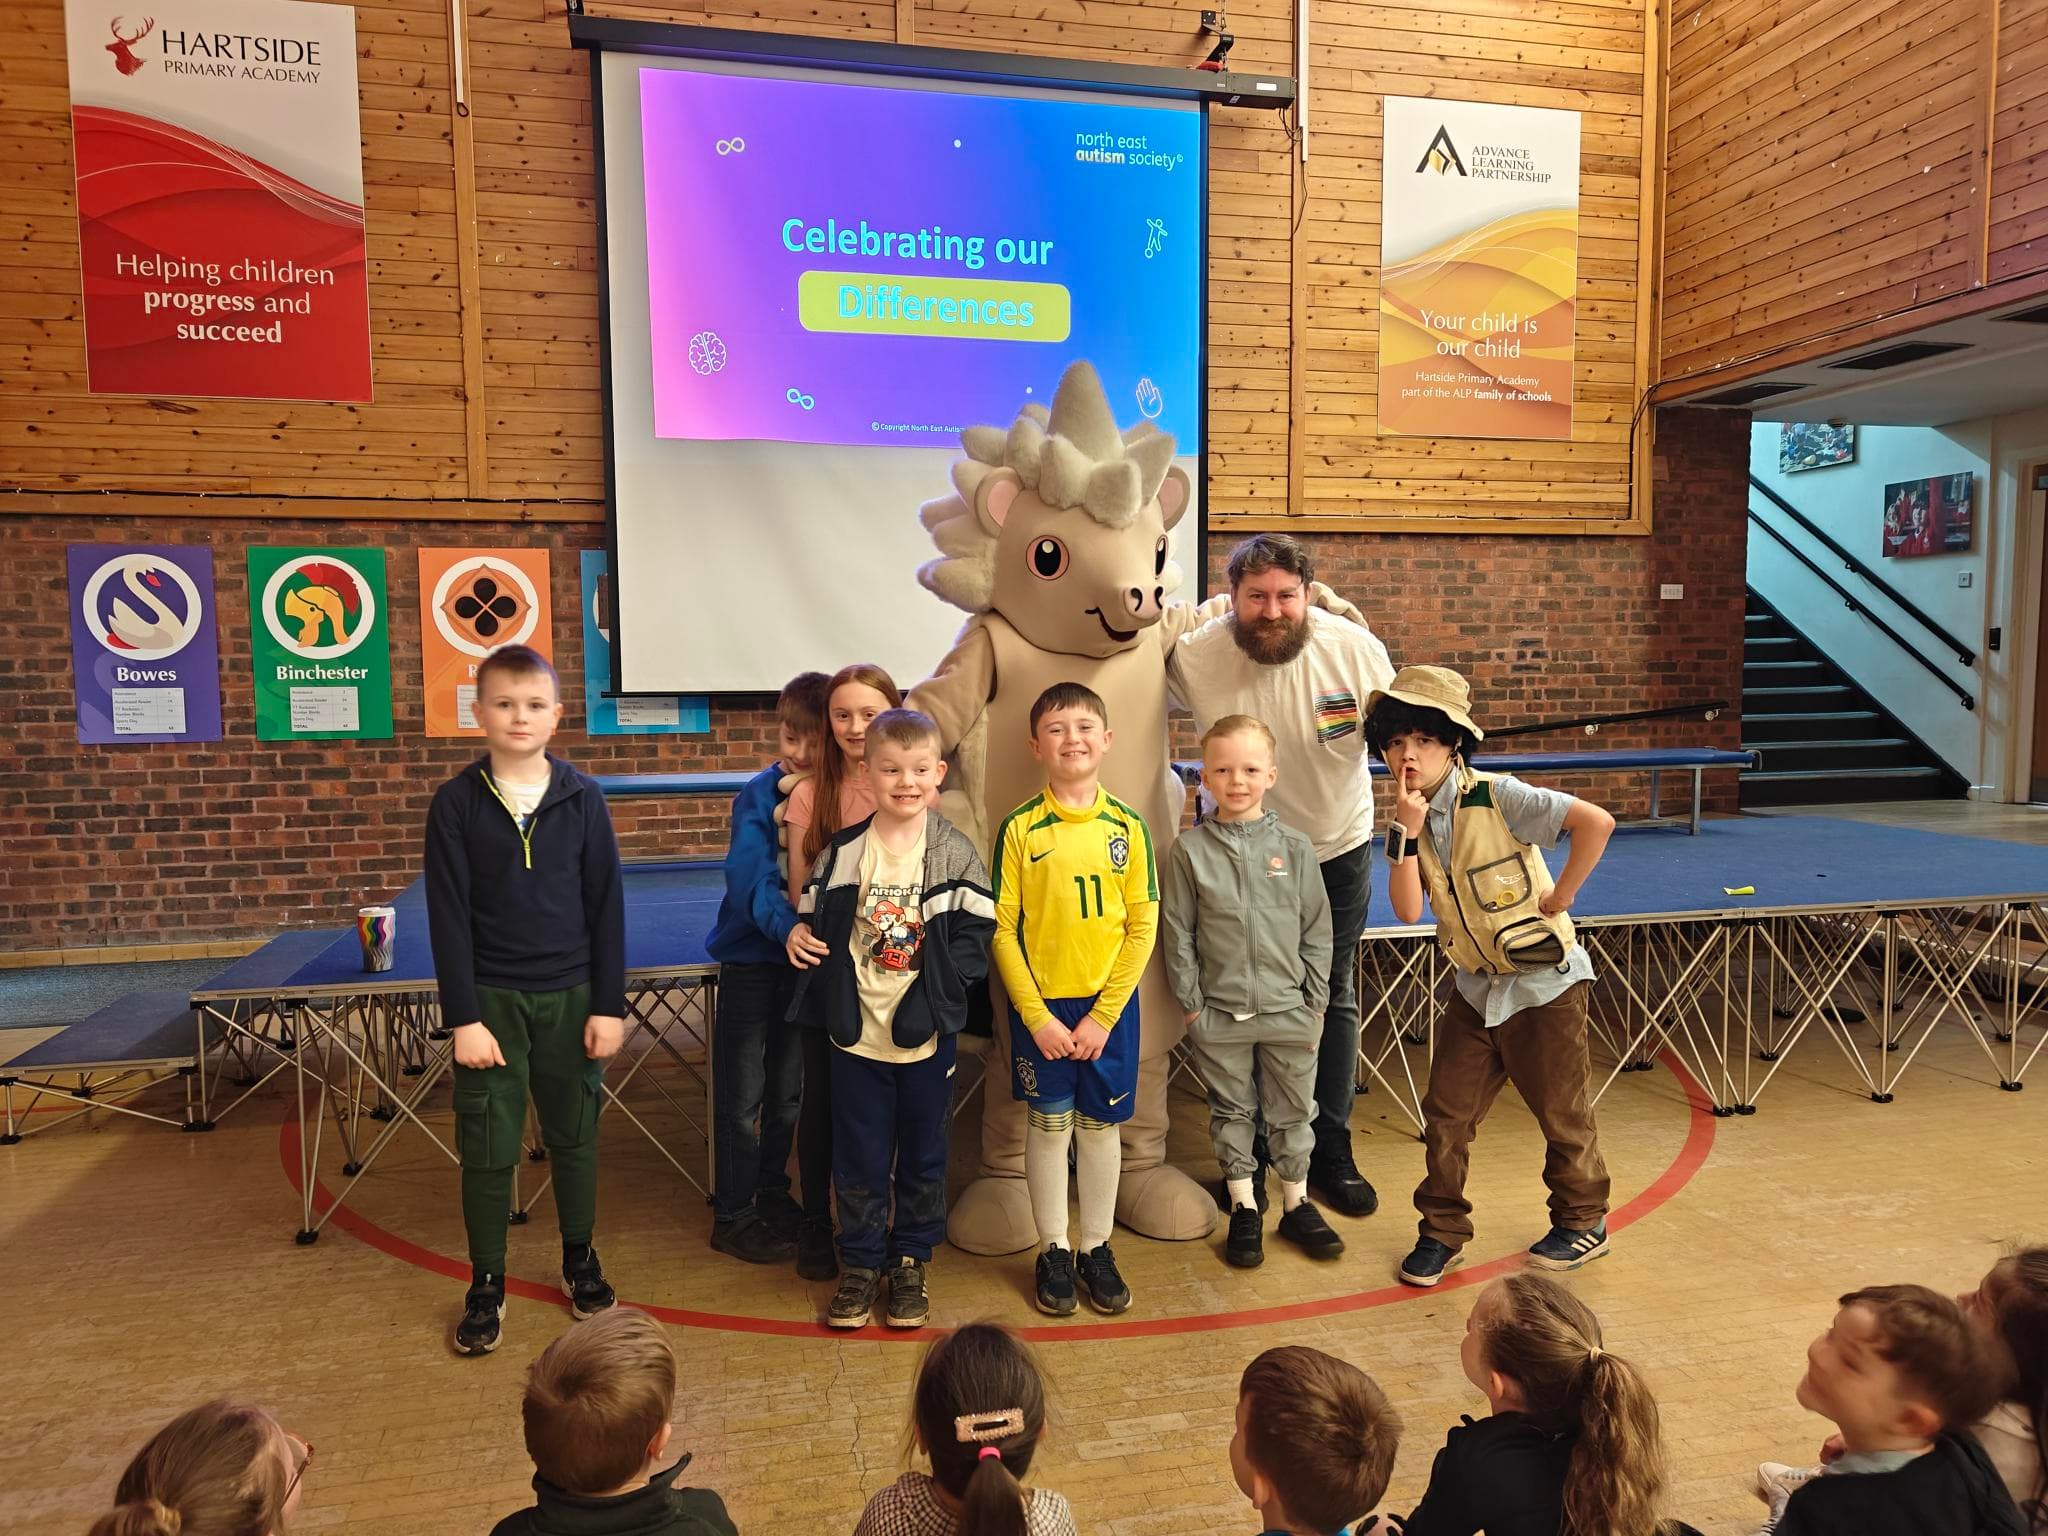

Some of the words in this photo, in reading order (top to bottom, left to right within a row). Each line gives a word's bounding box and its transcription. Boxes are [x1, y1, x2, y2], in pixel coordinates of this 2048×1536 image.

[162, 30, 321, 66] HARTSIDE
[164, 60, 236, 79] PRIMARY
[241, 67, 321, 84] ACADEMY
[1076, 131, 1114, 148] north
[1117, 136, 1147, 150] east
[1075, 148, 1125, 164] autism
[1472, 146, 1530, 160] ADVANCE
[1472, 157, 1534, 171] LEARNING
[1472, 168, 1552, 184] PARTNERSHIP
[781, 218, 985, 269] Celebrating
[995, 237, 1054, 265] our
[116, 253, 221, 286] Helping
[229, 258, 334, 285] children
[144, 290, 255, 316] progress
[264, 292, 310, 314] and
[838, 284, 1035, 328] Differences
[177, 321, 282, 343] succeed
[1421, 310, 1466, 330] Your
[1471, 312, 1517, 333] child
[1524, 315, 1538, 334] is
[1436, 341, 1468, 356] our
[1474, 337, 1521, 358] child
[1415, 371, 1456, 383] Hartside
[1458, 373, 1495, 386] Primary
[1497, 375, 1540, 387] Academy
[1402, 386, 1421, 399] part
[1423, 387, 1434, 397] of
[1435, 387, 1451, 399] the
[1453, 388, 1472, 399] ALP
[1474, 390, 1503, 402] family
[1506, 389, 1516, 400] of
[1518, 391, 1552, 402] schools
[880, 423, 910, 431] Copyright
[911, 424, 929, 432] North
[117, 667, 177, 682] Bowes
[276, 664, 368, 680] Binchester
[1074, 874, 1103, 919] 11
